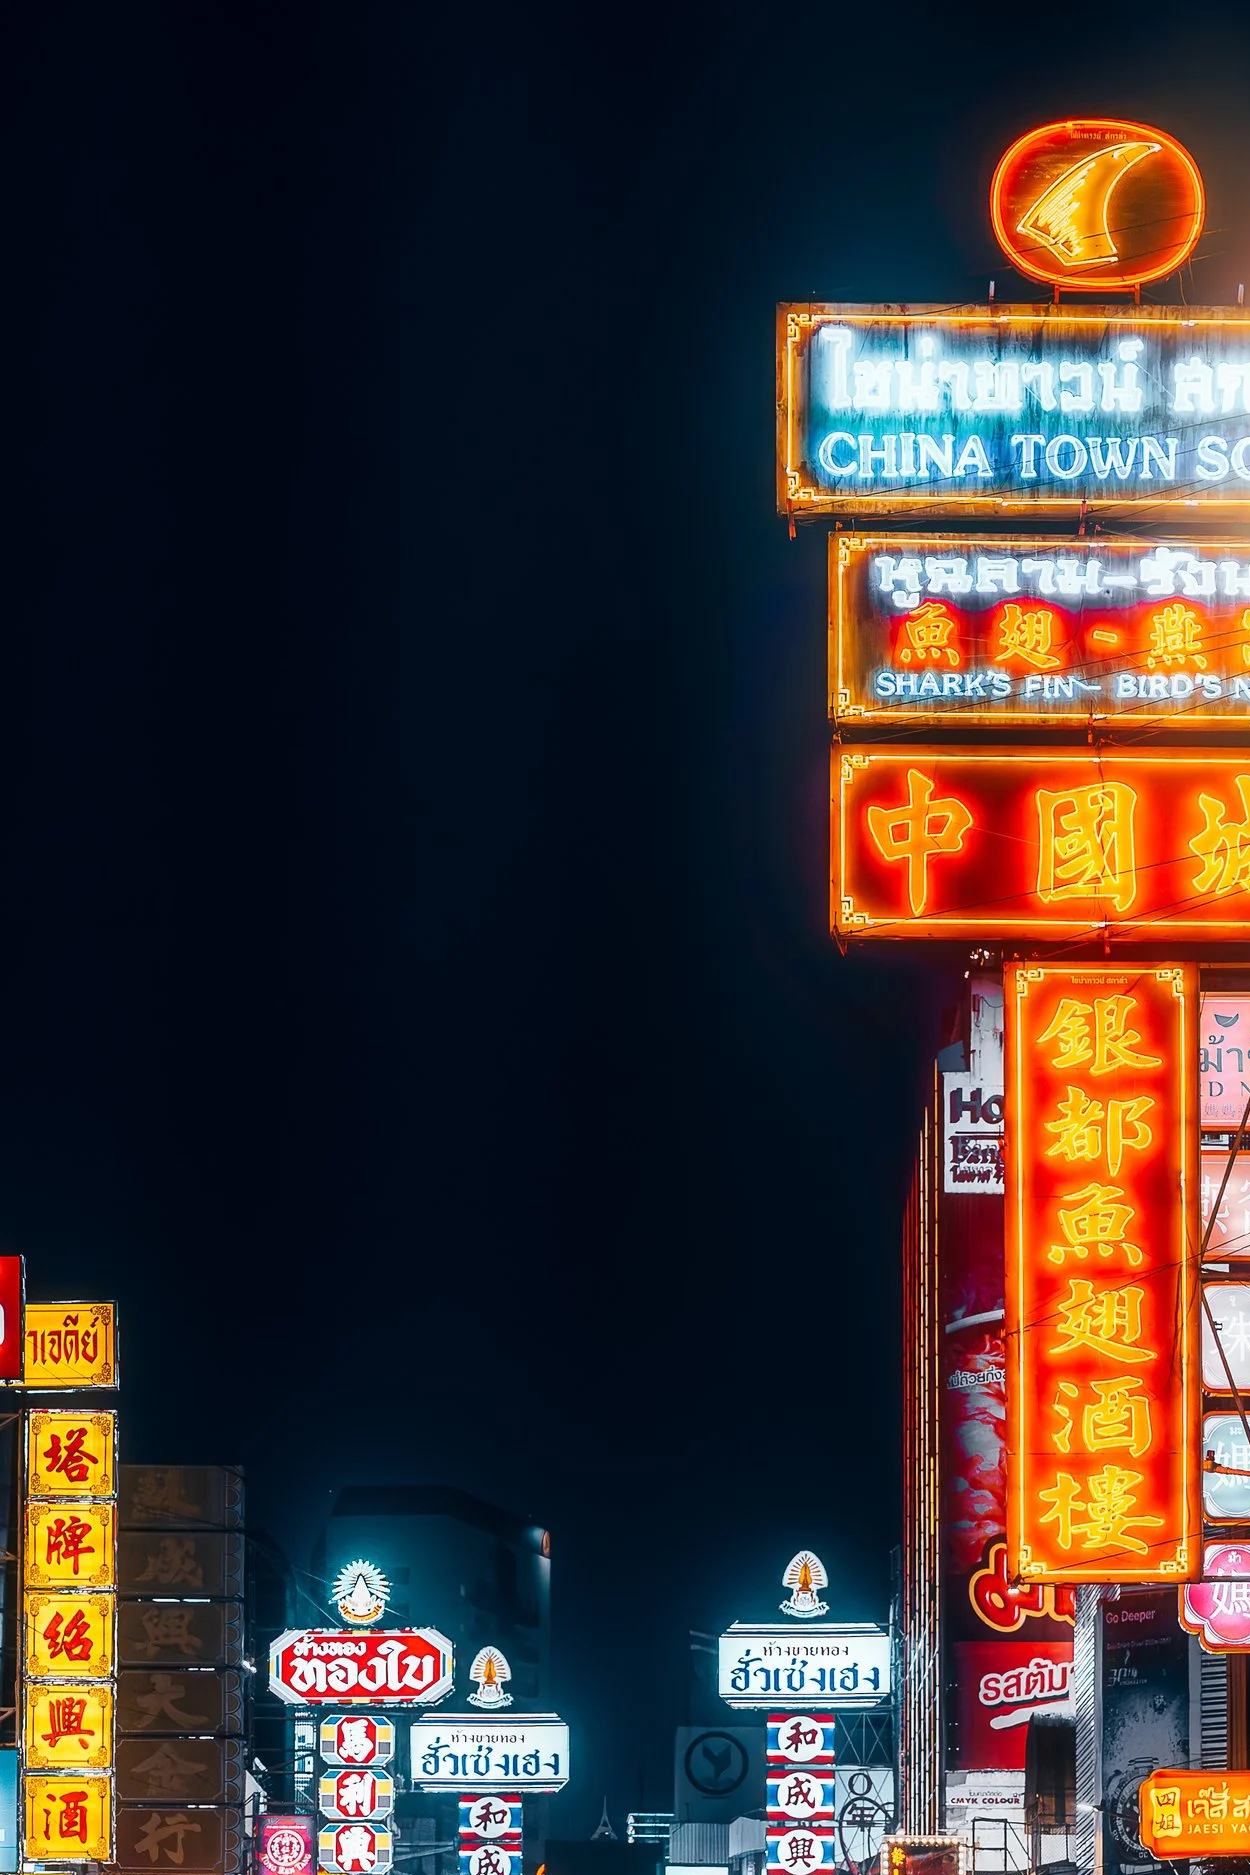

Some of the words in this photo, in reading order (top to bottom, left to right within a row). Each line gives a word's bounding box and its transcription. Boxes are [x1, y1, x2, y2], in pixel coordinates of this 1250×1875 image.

[820, 327, 1144, 414] ไชน่าทาวน์
[817, 432, 994, 480] CHINA
[1010, 434, 1178, 481] TOWN
[876, 671, 1012, 698] SHARK'S
[1116, 673, 1222, 698] BIRD'S
[1035, 994, 1166, 1556] 銀都魚翅酒樓
[1105, 1612, 1119, 1624] Go
[1121, 1609, 1156, 1624] Deeper
[289, 1639, 436, 1693] ทองใบ
[763, 1642, 850, 1657] ห้างขายทอง
[730, 1648, 880, 1694] ฮั่วเซ่งเฮง
[421, 1736, 560, 1778] ฮั่วเซ่งเฮง
[950, 1797, 978, 1805] CMYK
[981, 1796, 1021, 1805] COLOUR
[1155, 1790, 1181, 1832] 四姐
[1187, 1823, 1224, 1834] JAESI
